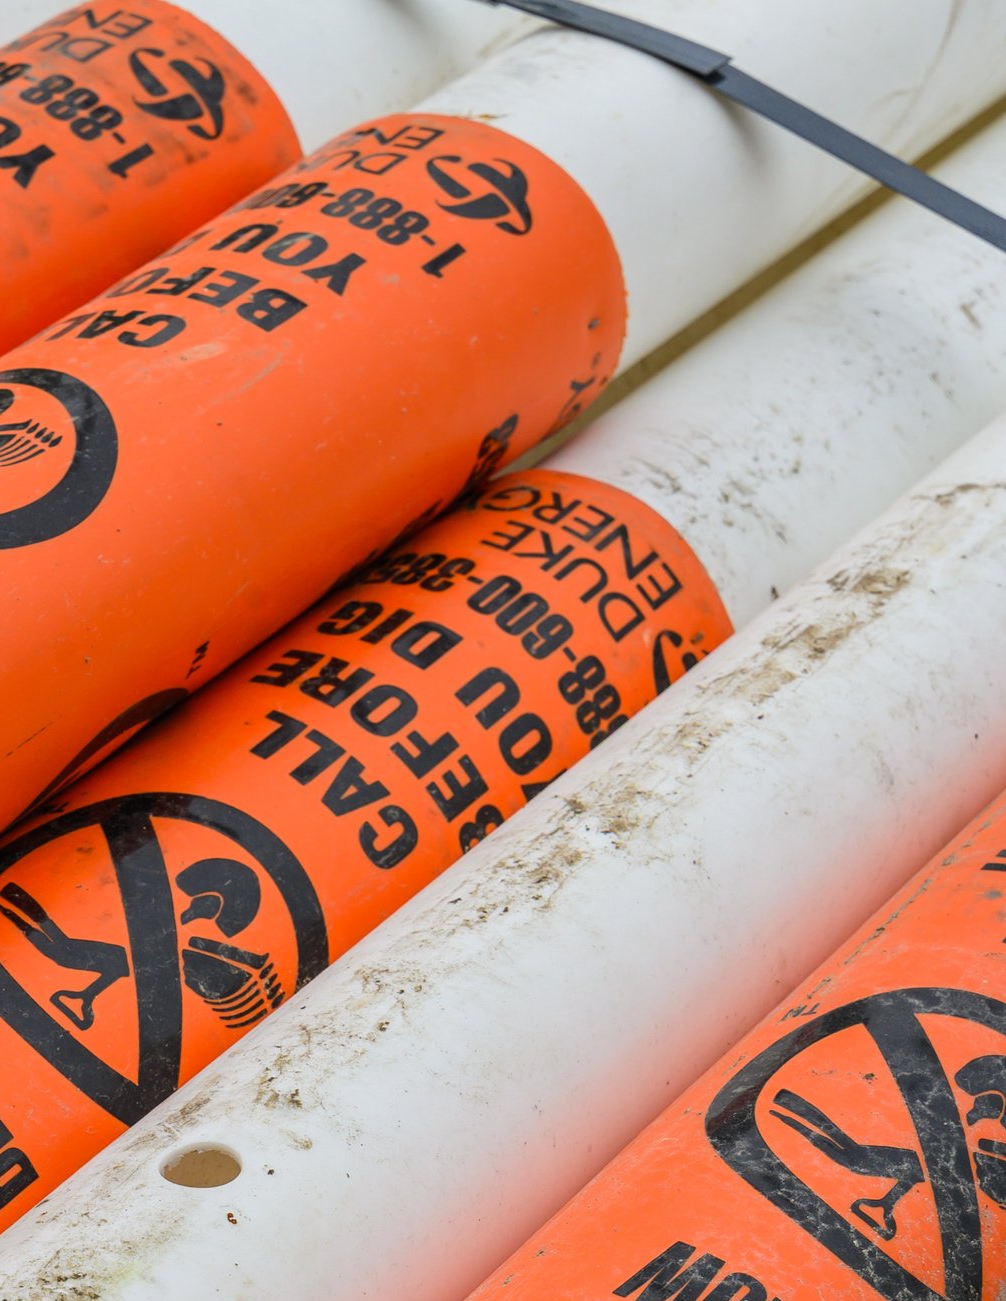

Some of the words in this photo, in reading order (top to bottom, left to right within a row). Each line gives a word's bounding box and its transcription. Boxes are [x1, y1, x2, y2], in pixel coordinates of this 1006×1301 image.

[104, 267, 308, 332] BEFO
[208, 223, 367, 296] YOU
[480, 520, 646, 643] DUKE
[482, 486, 684, 611] ENERG
[317, 601, 463, 670] DIG
[250, 709, 419, 870] CALL
